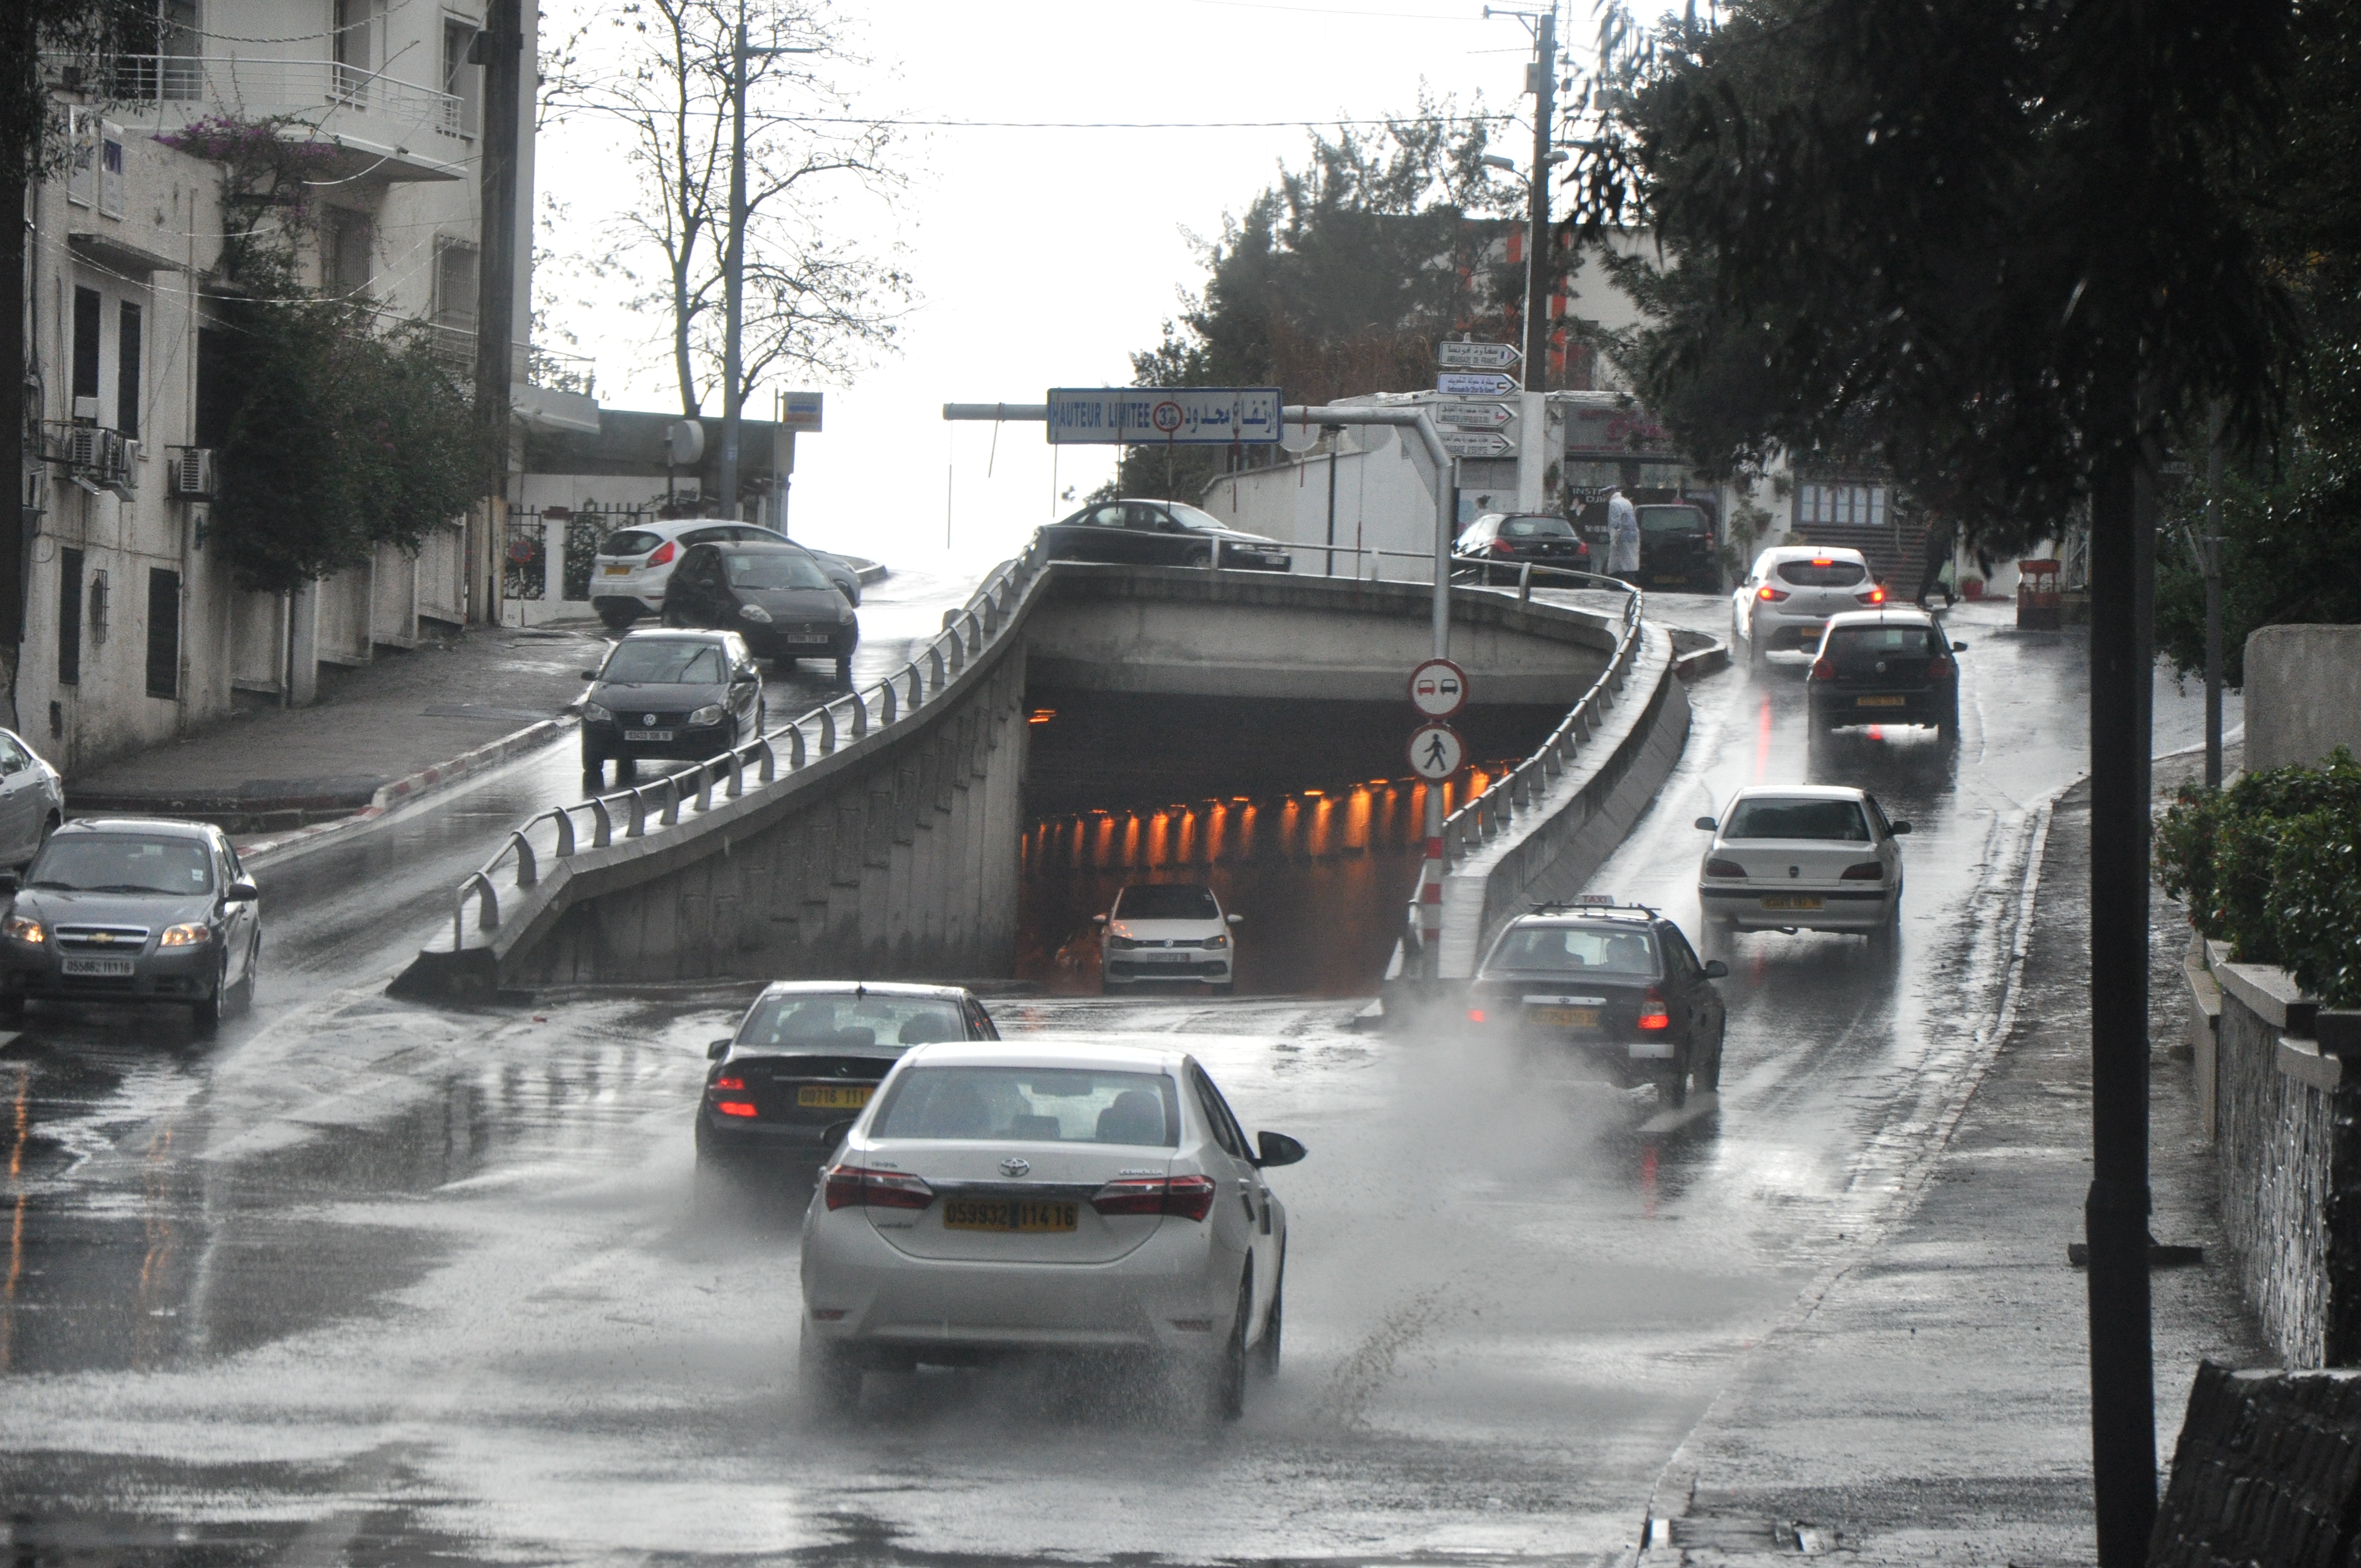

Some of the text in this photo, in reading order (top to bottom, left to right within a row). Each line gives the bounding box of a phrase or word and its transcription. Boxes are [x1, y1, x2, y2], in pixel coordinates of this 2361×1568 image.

[1048, 402, 1150, 428] HAUTEUR LIMITEE
[1185, 405, 1230, 433] محدود
[1582, 895, 1607, 903] TAXI
